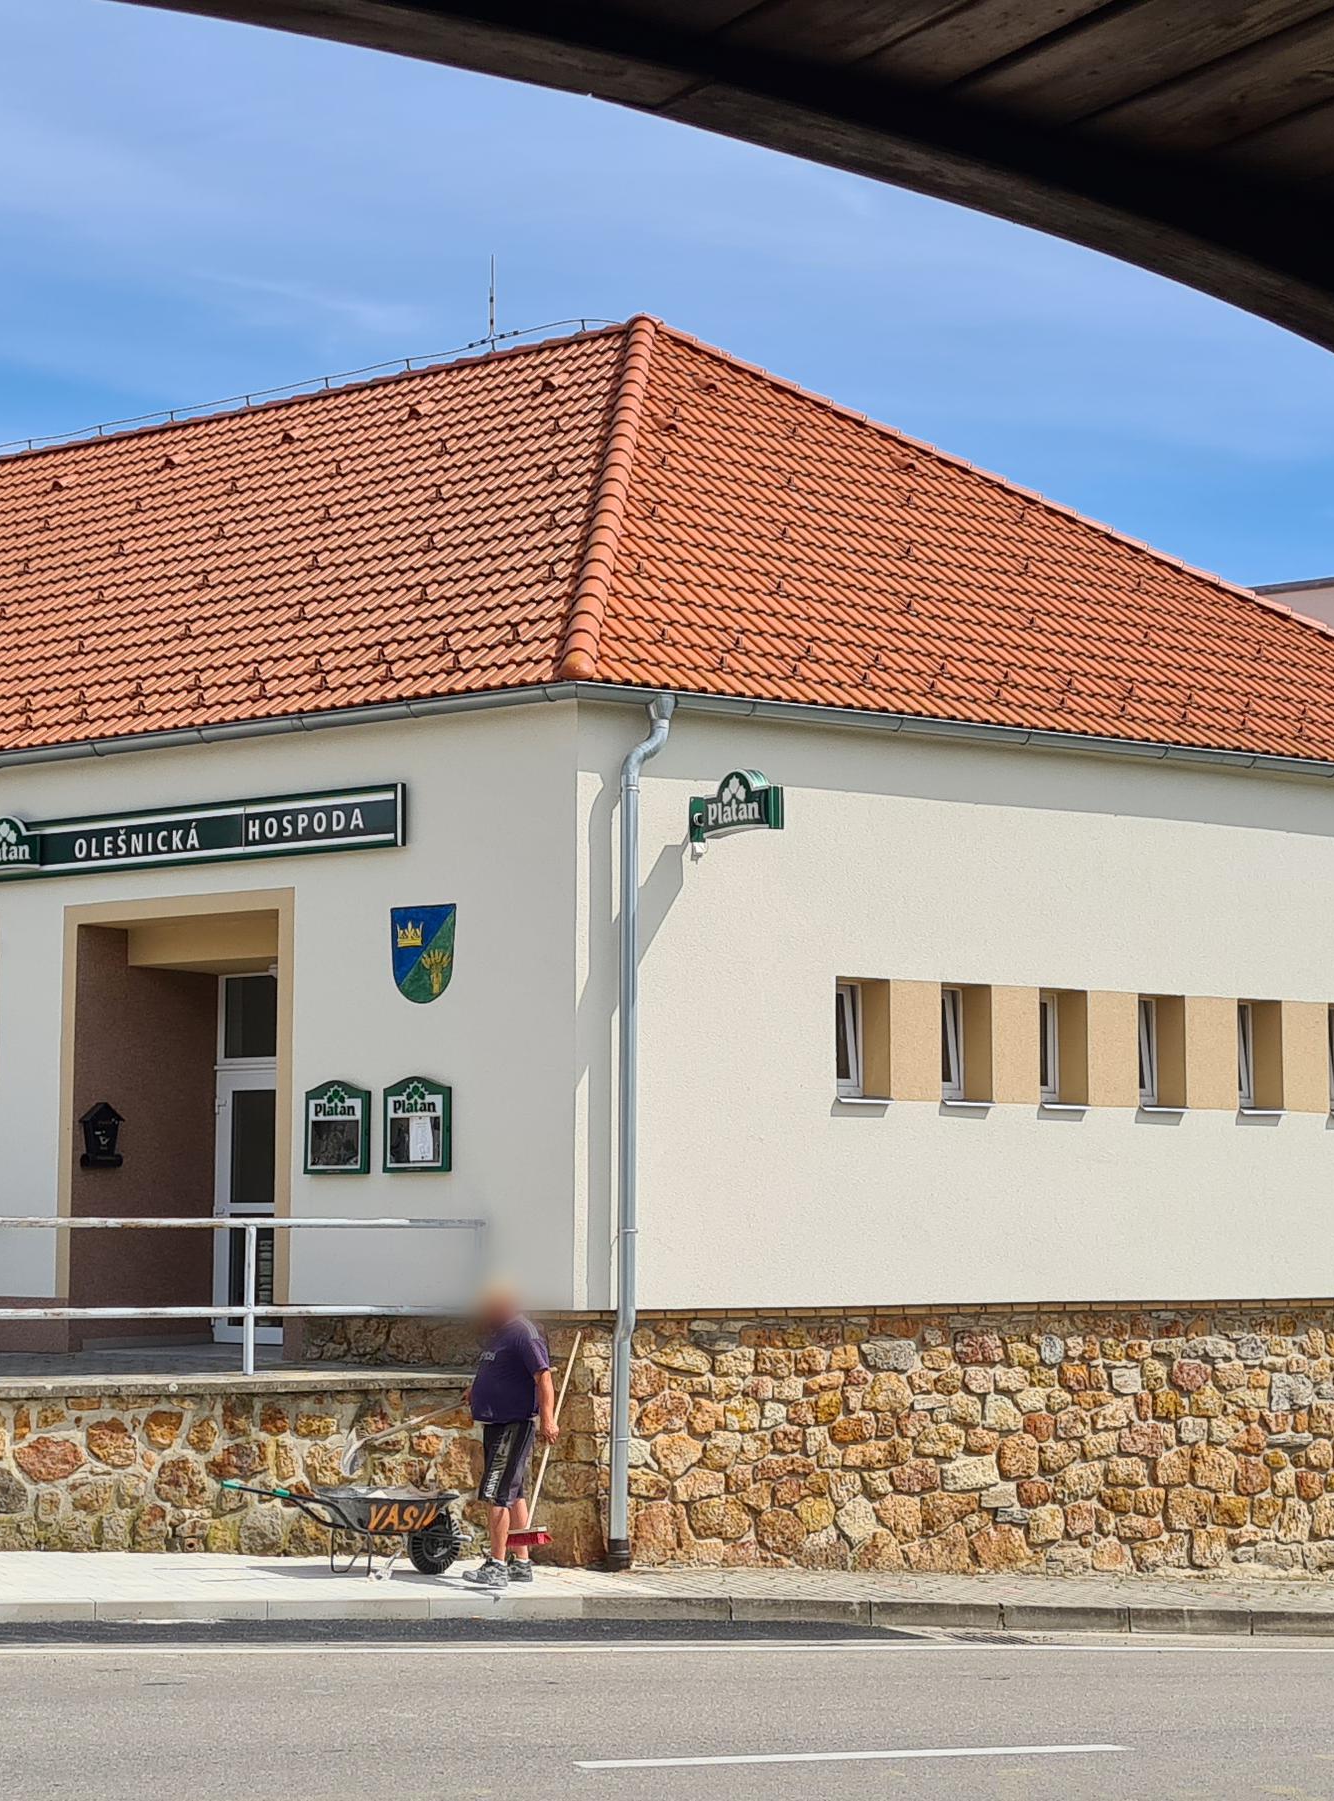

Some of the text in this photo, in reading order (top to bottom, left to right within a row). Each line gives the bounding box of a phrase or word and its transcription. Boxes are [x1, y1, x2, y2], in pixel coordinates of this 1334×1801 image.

[707, 799, 761, 826] Platan
[74, 807, 364, 859] OLEŠNICKÁ HOSPODA
[314, 1101, 357, 1117] Platan
[393, 1098, 437, 1114] Platan
